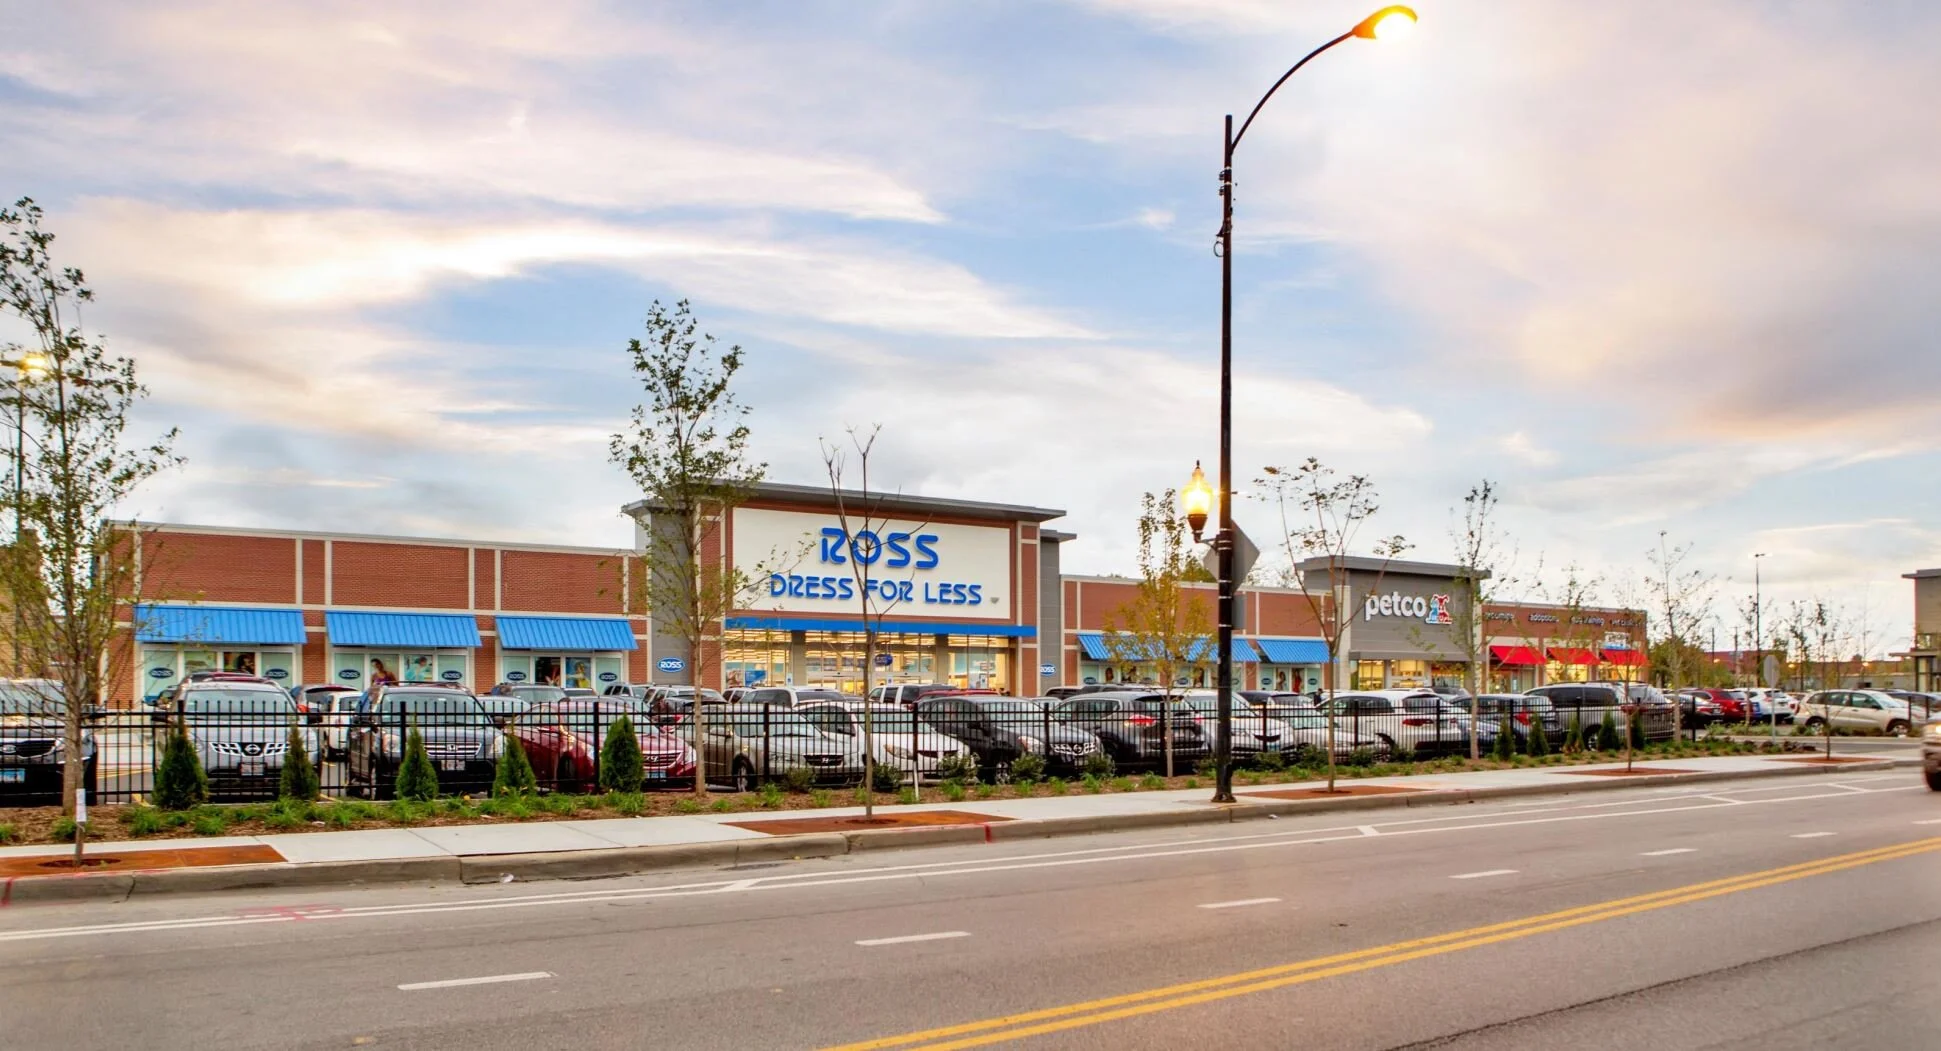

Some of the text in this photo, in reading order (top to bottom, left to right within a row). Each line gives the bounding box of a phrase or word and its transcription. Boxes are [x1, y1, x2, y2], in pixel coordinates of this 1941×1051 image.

[821, 527, 939, 569] ROSS
[770, 573, 982, 605] DRESS FOR LESS
[1365, 591, 1427, 621] petco
[659, 661, 683, 669] ROSS
